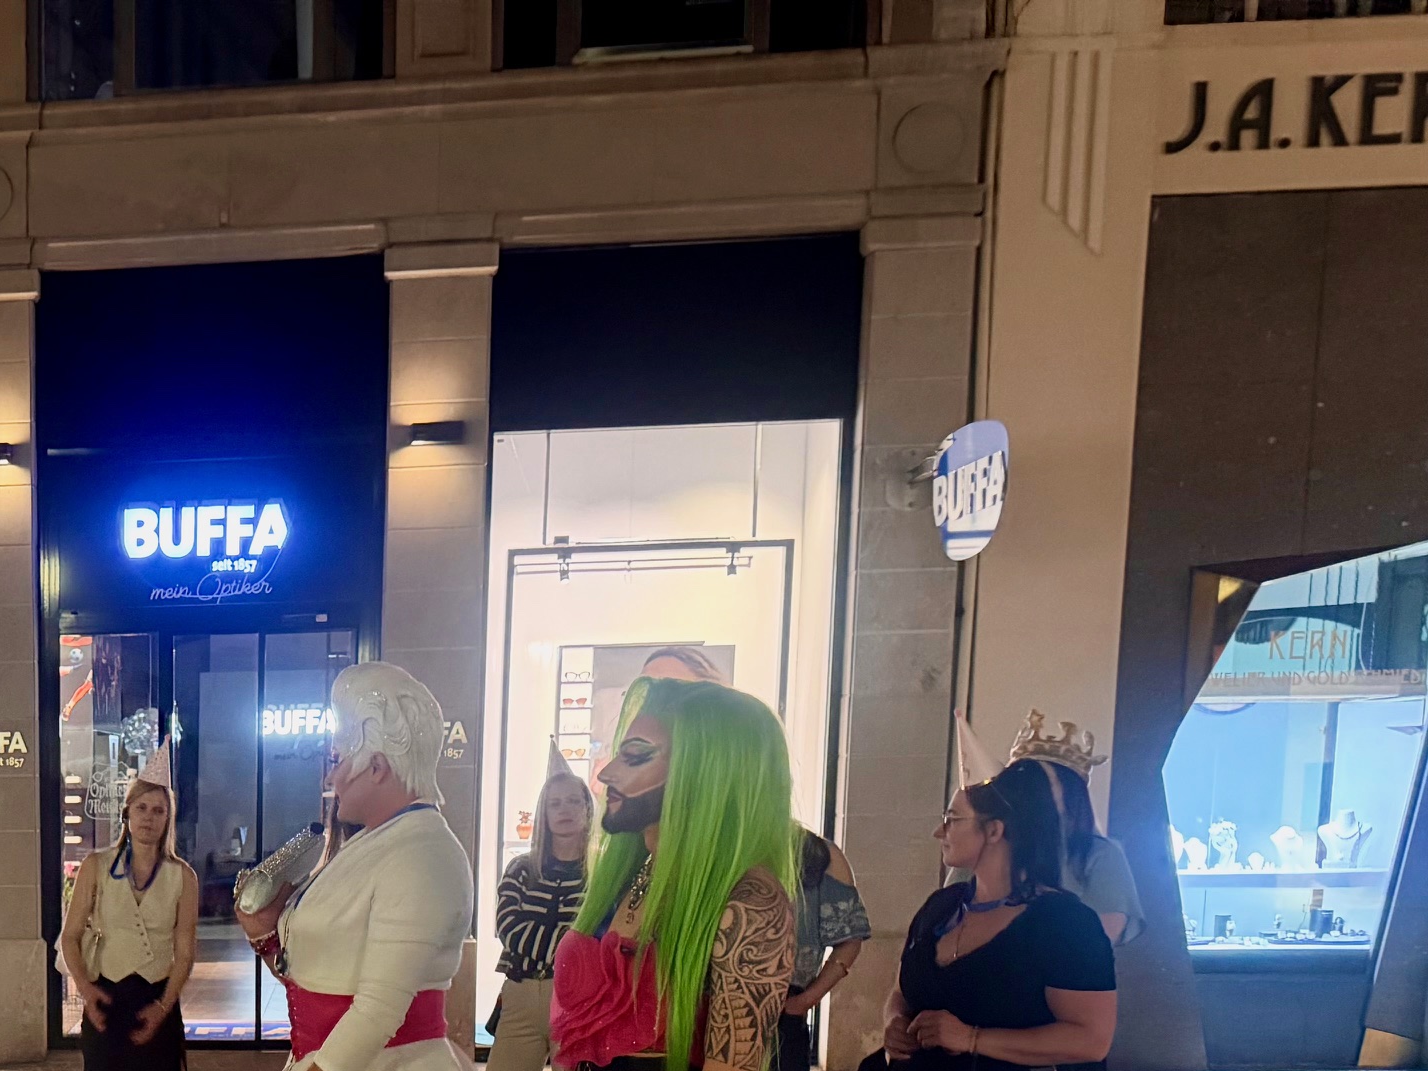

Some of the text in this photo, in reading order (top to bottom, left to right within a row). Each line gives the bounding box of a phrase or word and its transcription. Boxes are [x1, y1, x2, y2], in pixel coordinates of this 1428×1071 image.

[933, 450, 1005, 527] BUFFA
[123, 502, 289, 559] BUFFA
[211, 558, 258, 573] seit 1857
[150, 573, 273, 605] mein Optiker
[1269, 629, 1347, 661] KERN
[263, 707, 336, 735] BUFFA
[6, 757, 25, 768] 1857
